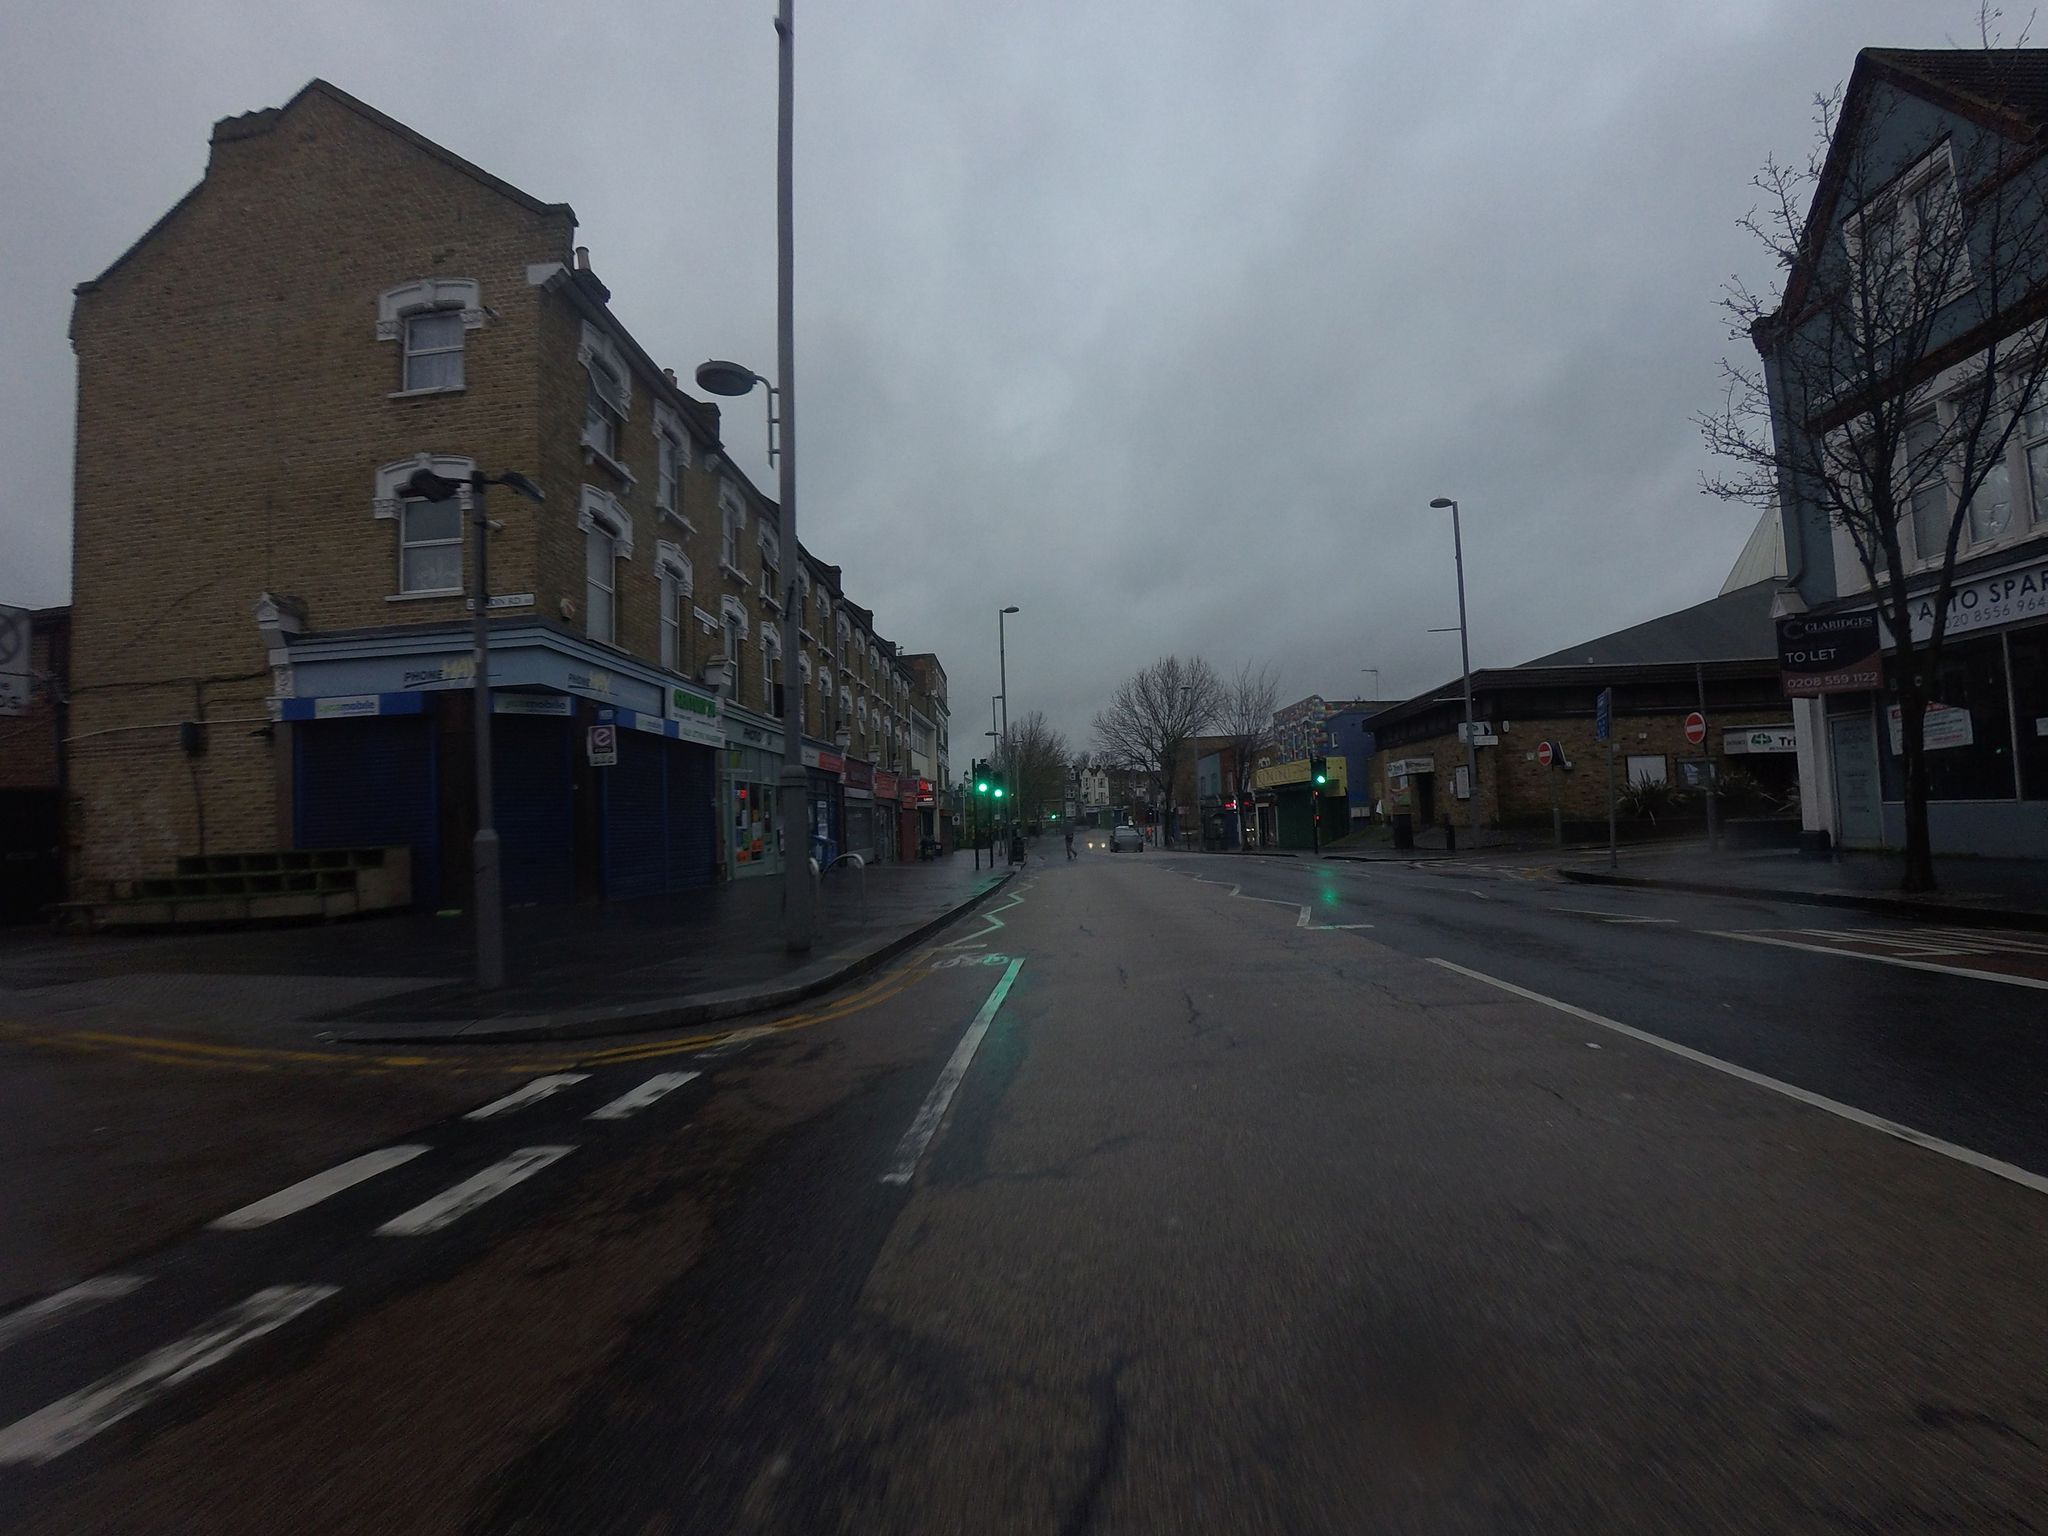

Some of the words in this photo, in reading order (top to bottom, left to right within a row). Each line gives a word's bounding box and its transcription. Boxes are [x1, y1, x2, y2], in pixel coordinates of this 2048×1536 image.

[1918, 589, 1979, 621] ATO
[1974, 603, 2011, 622] 8556
[1804, 616, 1873, 632] CLARIDGES
[1784, 651, 1807, 663] TO
[1808, 648, 1837, 661] LET
[404, 669, 443, 682] PHONE
[1787, 677, 1822, 688] 0208
[1824, 674, 1849, 685] 559
[1853, 671, 1878, 683] 1122
